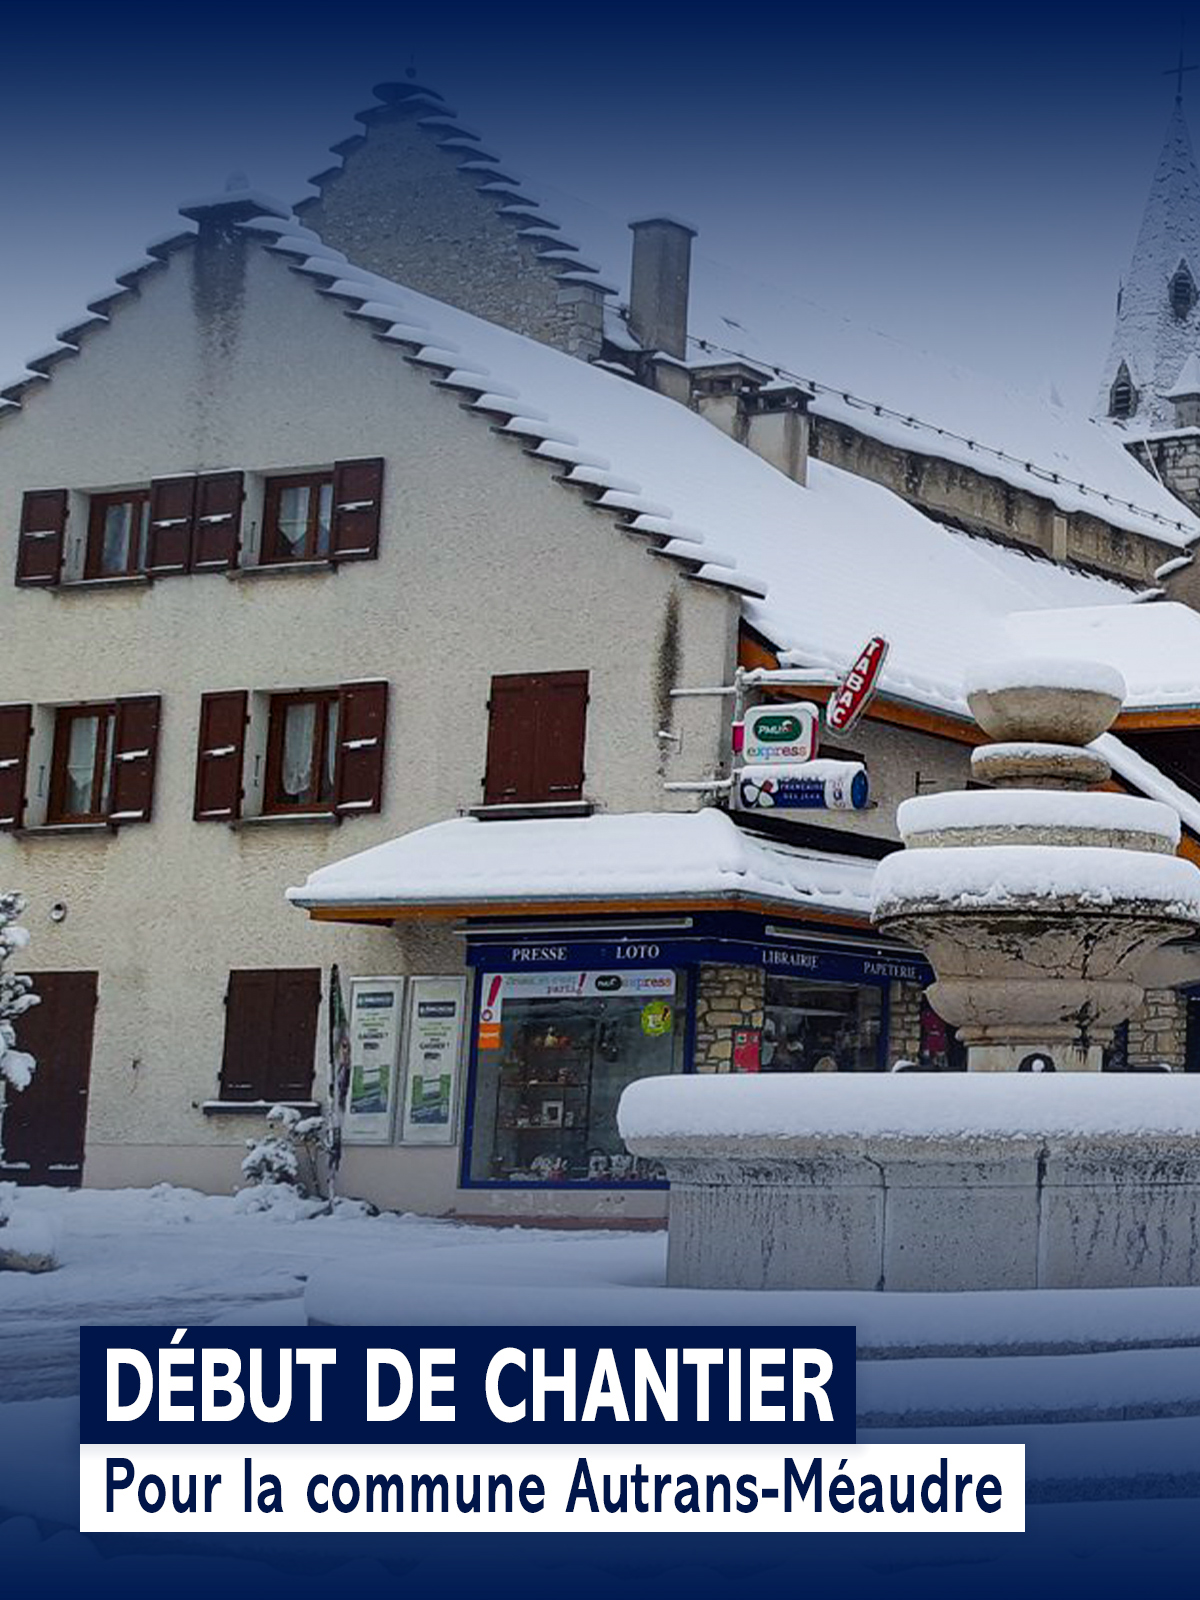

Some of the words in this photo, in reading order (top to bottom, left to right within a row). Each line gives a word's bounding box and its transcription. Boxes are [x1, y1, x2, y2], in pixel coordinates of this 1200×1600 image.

[833, 641, 882, 725] TABAC
[745, 741, 808, 760] express
[511, 946, 568, 963] PRESSE
[615, 944, 661, 960] LOTO
[761, 949, 820, 969] LIBRAIRIE
[863, 961, 917, 979] PAPETERIE
